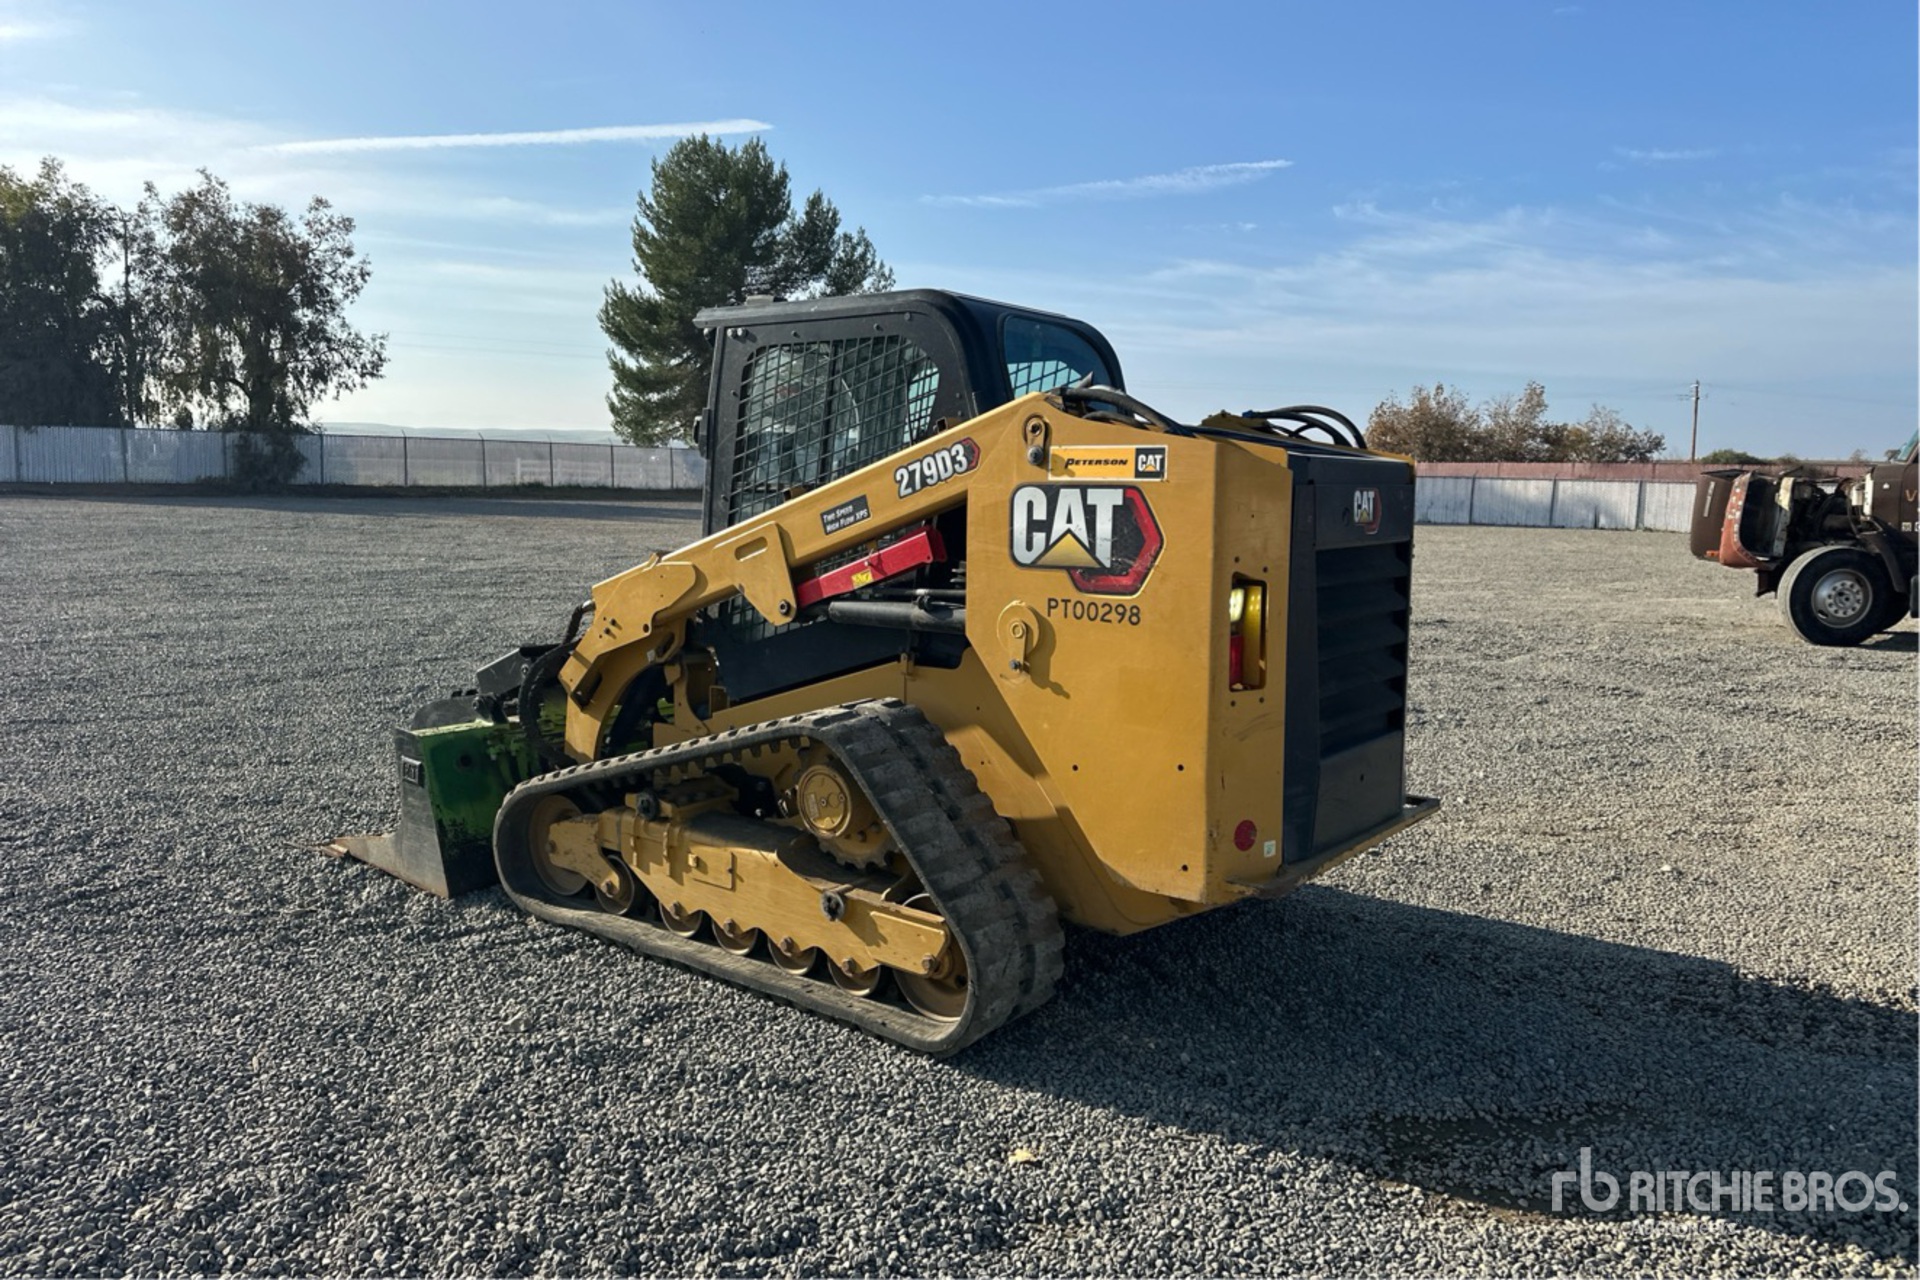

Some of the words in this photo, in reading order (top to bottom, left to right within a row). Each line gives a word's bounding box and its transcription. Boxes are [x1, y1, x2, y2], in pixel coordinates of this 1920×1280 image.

[895, 443, 968, 497] 279D3
[1064, 458, 1128, 470] PETERSON
[1137, 454, 1163, 472] CAT
[1353, 489, 1375, 523] CAT
[1013, 486, 1124, 568] CAT
[1047, 598, 1141, 626] PT00298
